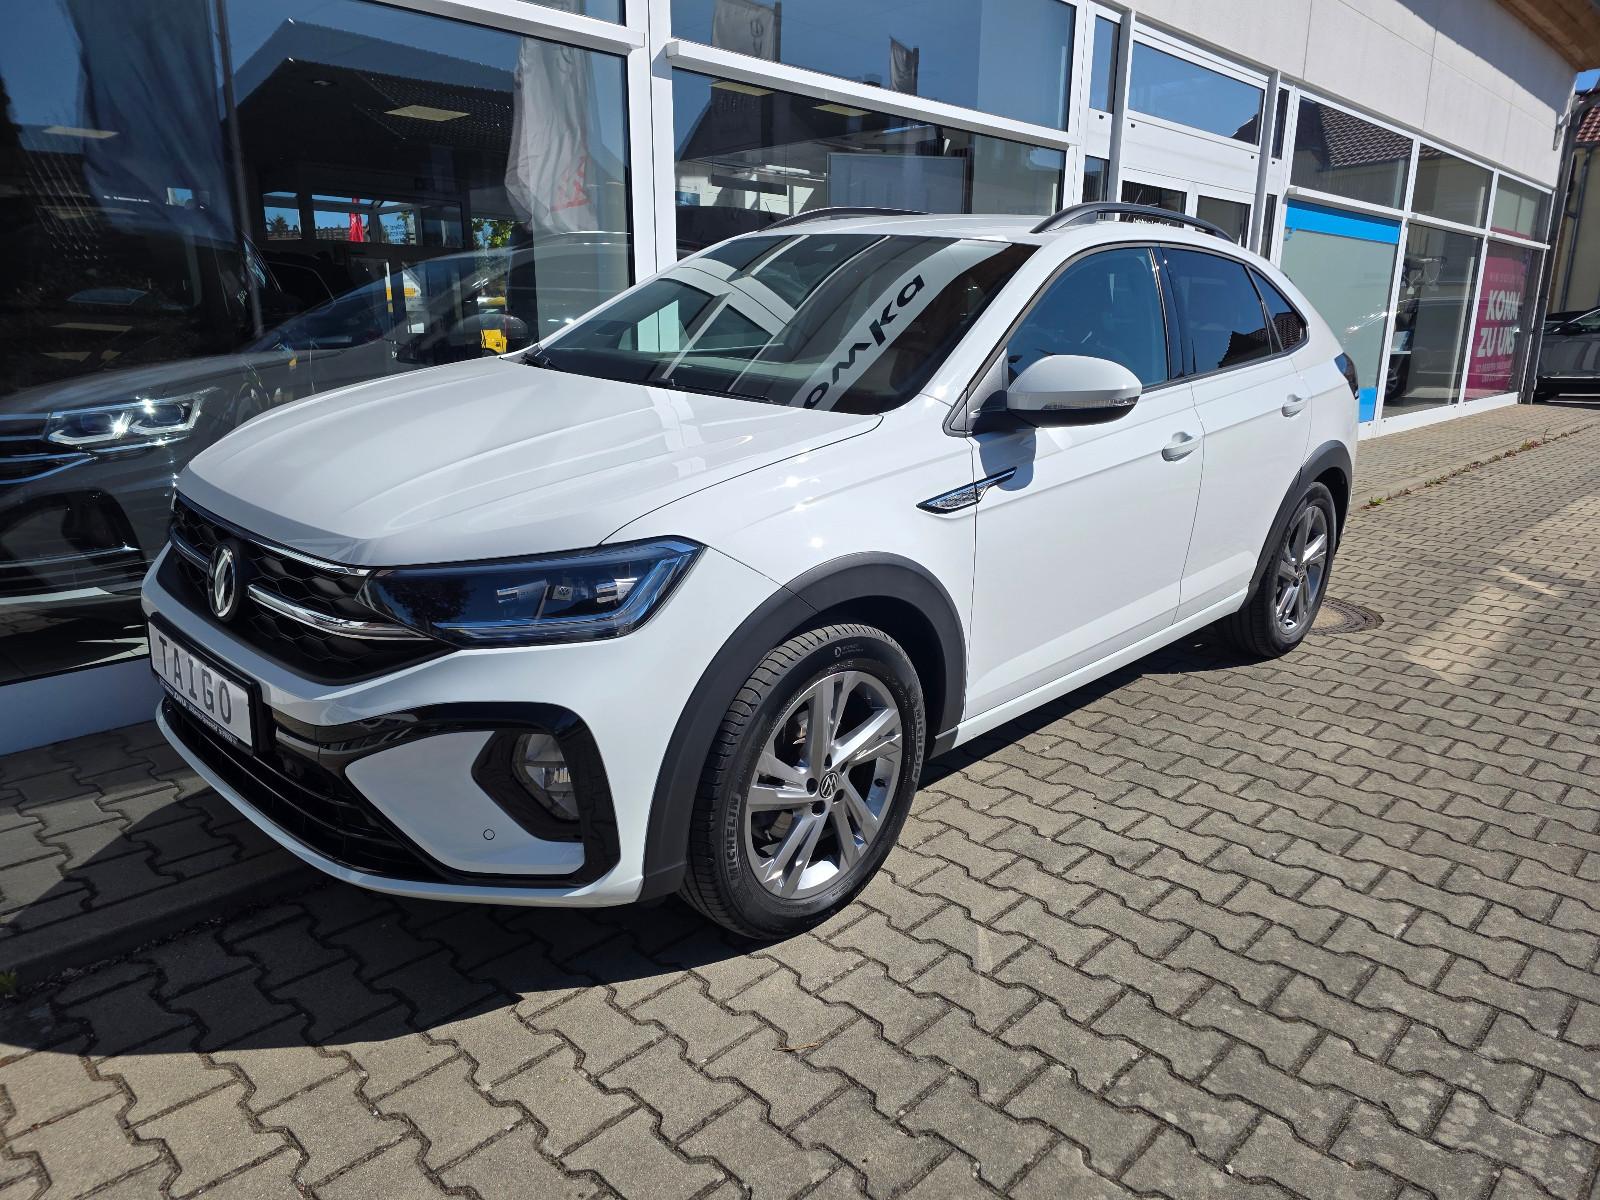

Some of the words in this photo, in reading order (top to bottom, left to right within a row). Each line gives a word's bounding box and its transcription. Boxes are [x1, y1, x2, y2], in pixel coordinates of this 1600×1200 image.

[1476, 327, 1497, 358] ZU
[1497, 326, 1517, 357] UNS
[158, 634, 232, 725] TAIGO
[726, 797, 740, 881] MICHELIN
